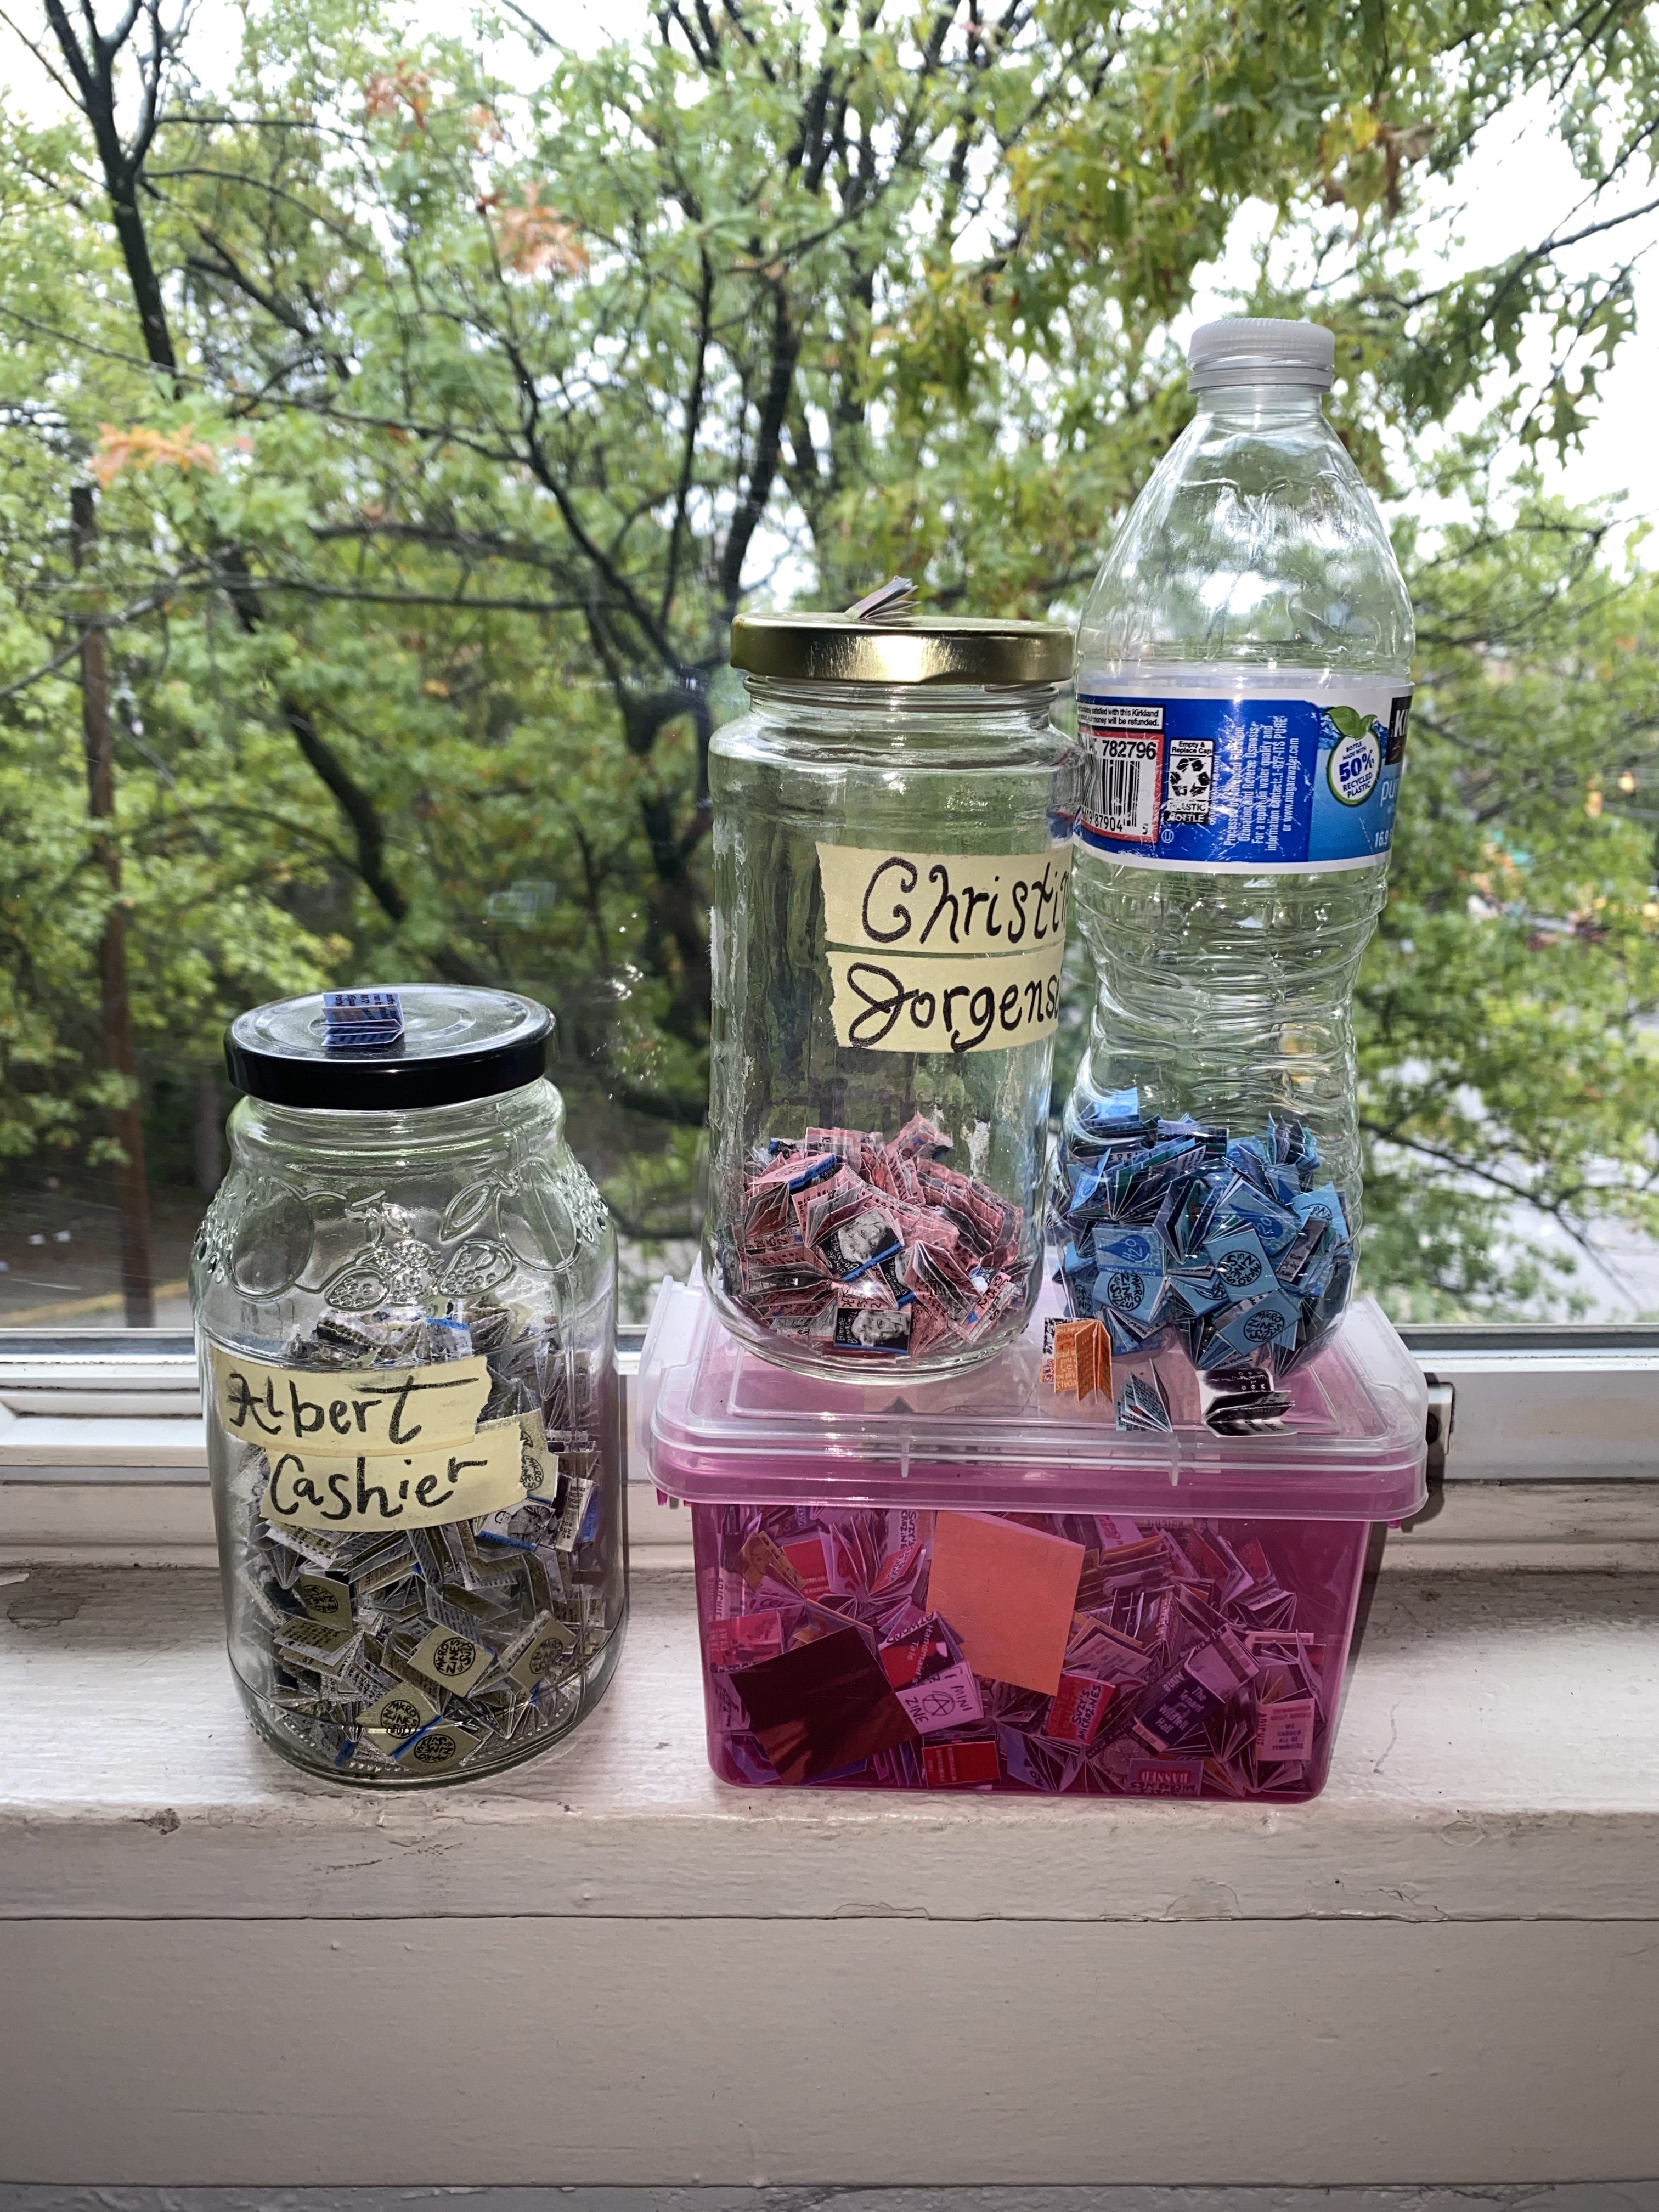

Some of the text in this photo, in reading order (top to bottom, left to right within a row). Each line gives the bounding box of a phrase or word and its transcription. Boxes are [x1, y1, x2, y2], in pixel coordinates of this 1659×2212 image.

[1132, 709, 1159, 717] Kirkland
[1261, 725, 1273, 739] and
[1102, 740, 1156, 760] 782796
[1260, 742, 1273, 766] quality
[1346, 741, 1363, 753] BOTTLE
[1356, 746, 1367, 755] WITH
[1243, 760, 1256, 788] Reverse
[1339, 749, 1374, 782] 50%
[1258, 768, 1270, 788] water
[1283, 738, 1299, 822] www.niagarawater.com
[1343, 772, 1373, 792] RECYCLED
[1347, 781, 1370, 798] PLASTIC
[1095, 814, 1122, 832] 87904
[1142, 823, 1148, 834] 5
[1238, 806, 1253, 842] Ozonation
[1265, 810, 1279, 851] information
[1252, 832, 1265, 844] For
[1375, 831, 1389, 847] 16.9
[229, 1373, 479, 1445] Albert
[271, 1453, 487, 1520] Cashier
[907, 1641, 919, 1661] Tale
[912, 1623, 934, 1683] Handmaid's
[1163, 1671, 1186, 1692] Anne
[950, 1685, 973, 1711] MINI
[1179, 1689, 1205, 1713] Tenant
[1192, 1686, 1206, 1701] The
[905, 1696, 928, 1724] ZINE
[1072, 1690, 1089, 1724] SUZY'S
[1159, 1703, 1189, 1731] Wildfell
[1155, 1717, 1174, 1734] Hall
[1141, 1771, 1188, 1784] BANNED
